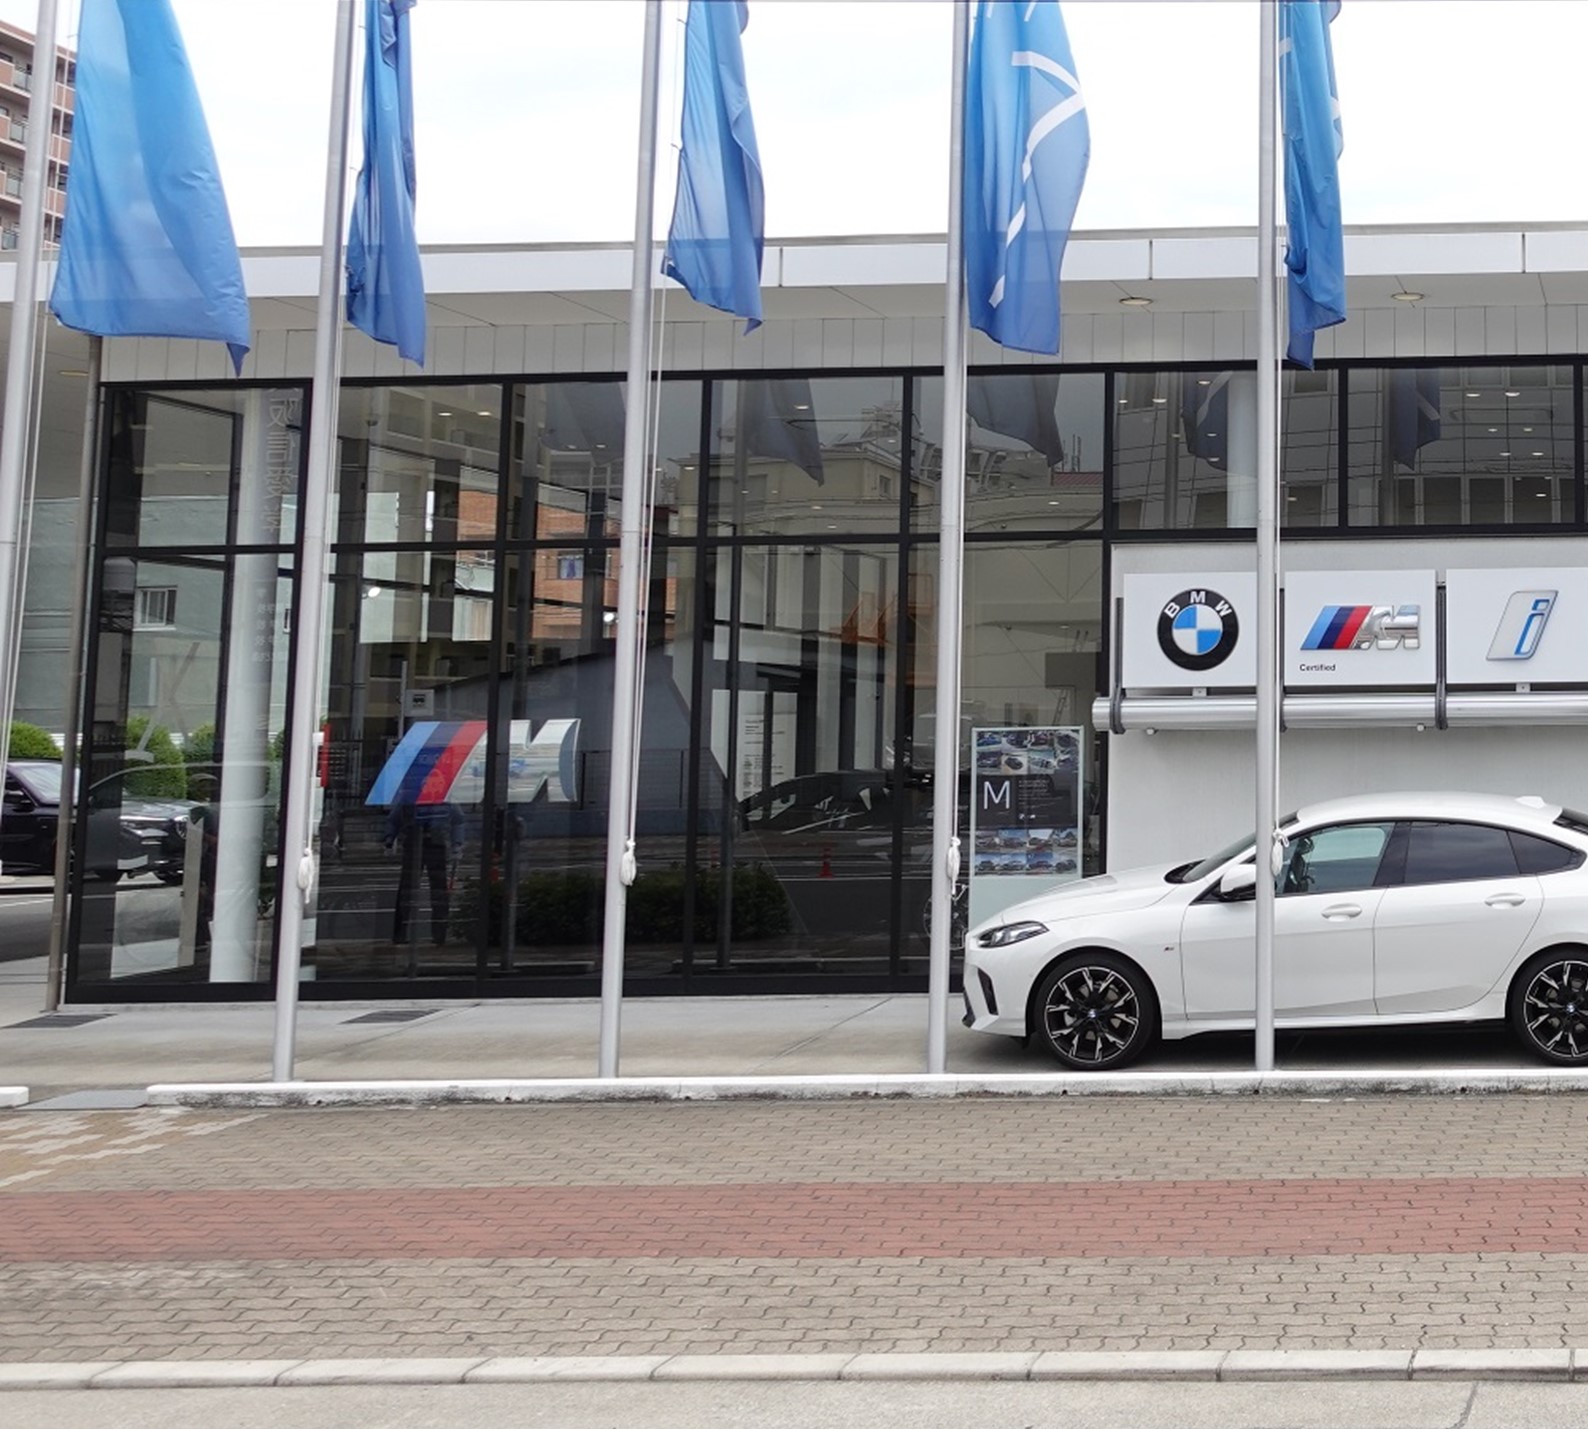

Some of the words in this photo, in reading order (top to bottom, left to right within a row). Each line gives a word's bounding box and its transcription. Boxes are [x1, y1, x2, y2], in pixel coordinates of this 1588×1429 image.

[1163, 590, 1233, 619] BMW
[1299, 663, 1336, 672] Certified
[983, 780, 1011, 810] M
